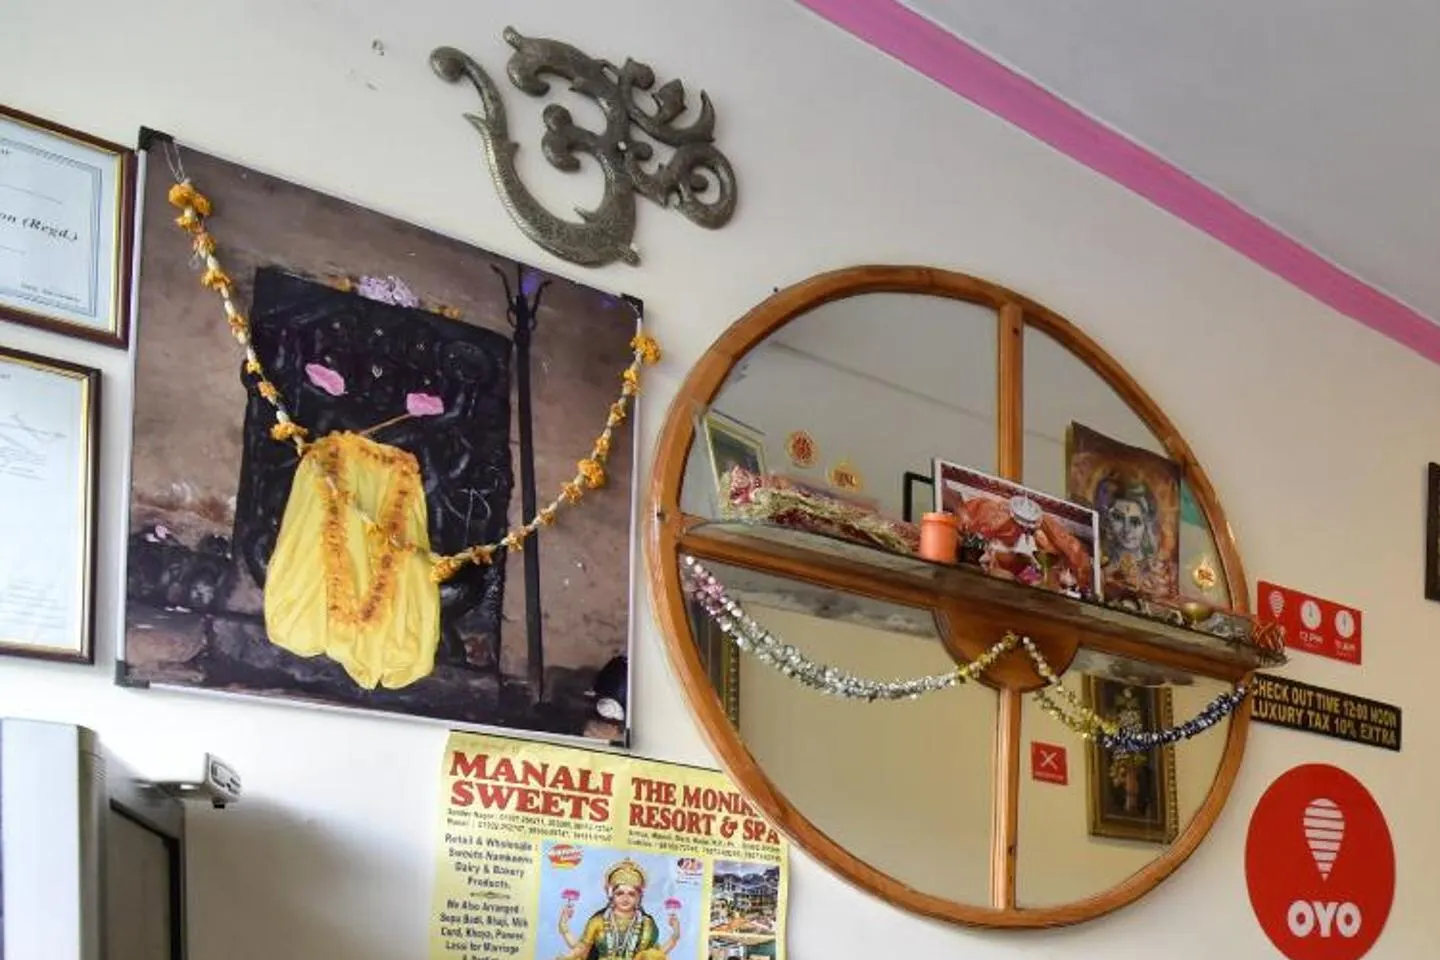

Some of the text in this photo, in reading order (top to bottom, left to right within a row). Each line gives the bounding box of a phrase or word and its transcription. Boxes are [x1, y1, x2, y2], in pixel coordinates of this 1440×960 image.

[1252, 676, 1289, 702] CHECK
[1292, 687, 1314, 707] OUT
[1316, 692, 1341, 714] TIME
[1251, 698, 1397, 745] LUXURY TAX 10% EXTRA
[449, 750, 615, 796] MANALI
[631, 777, 677, 806] THE
[450, 779, 610, 823] SWEETS
[445, 833, 473, 845] Retail
[629, 803, 717, 836] RESORT
[720, 815, 738, 839] &
[743, 818, 780, 845] SPA
[1287, 900, 1362, 938] OYO
